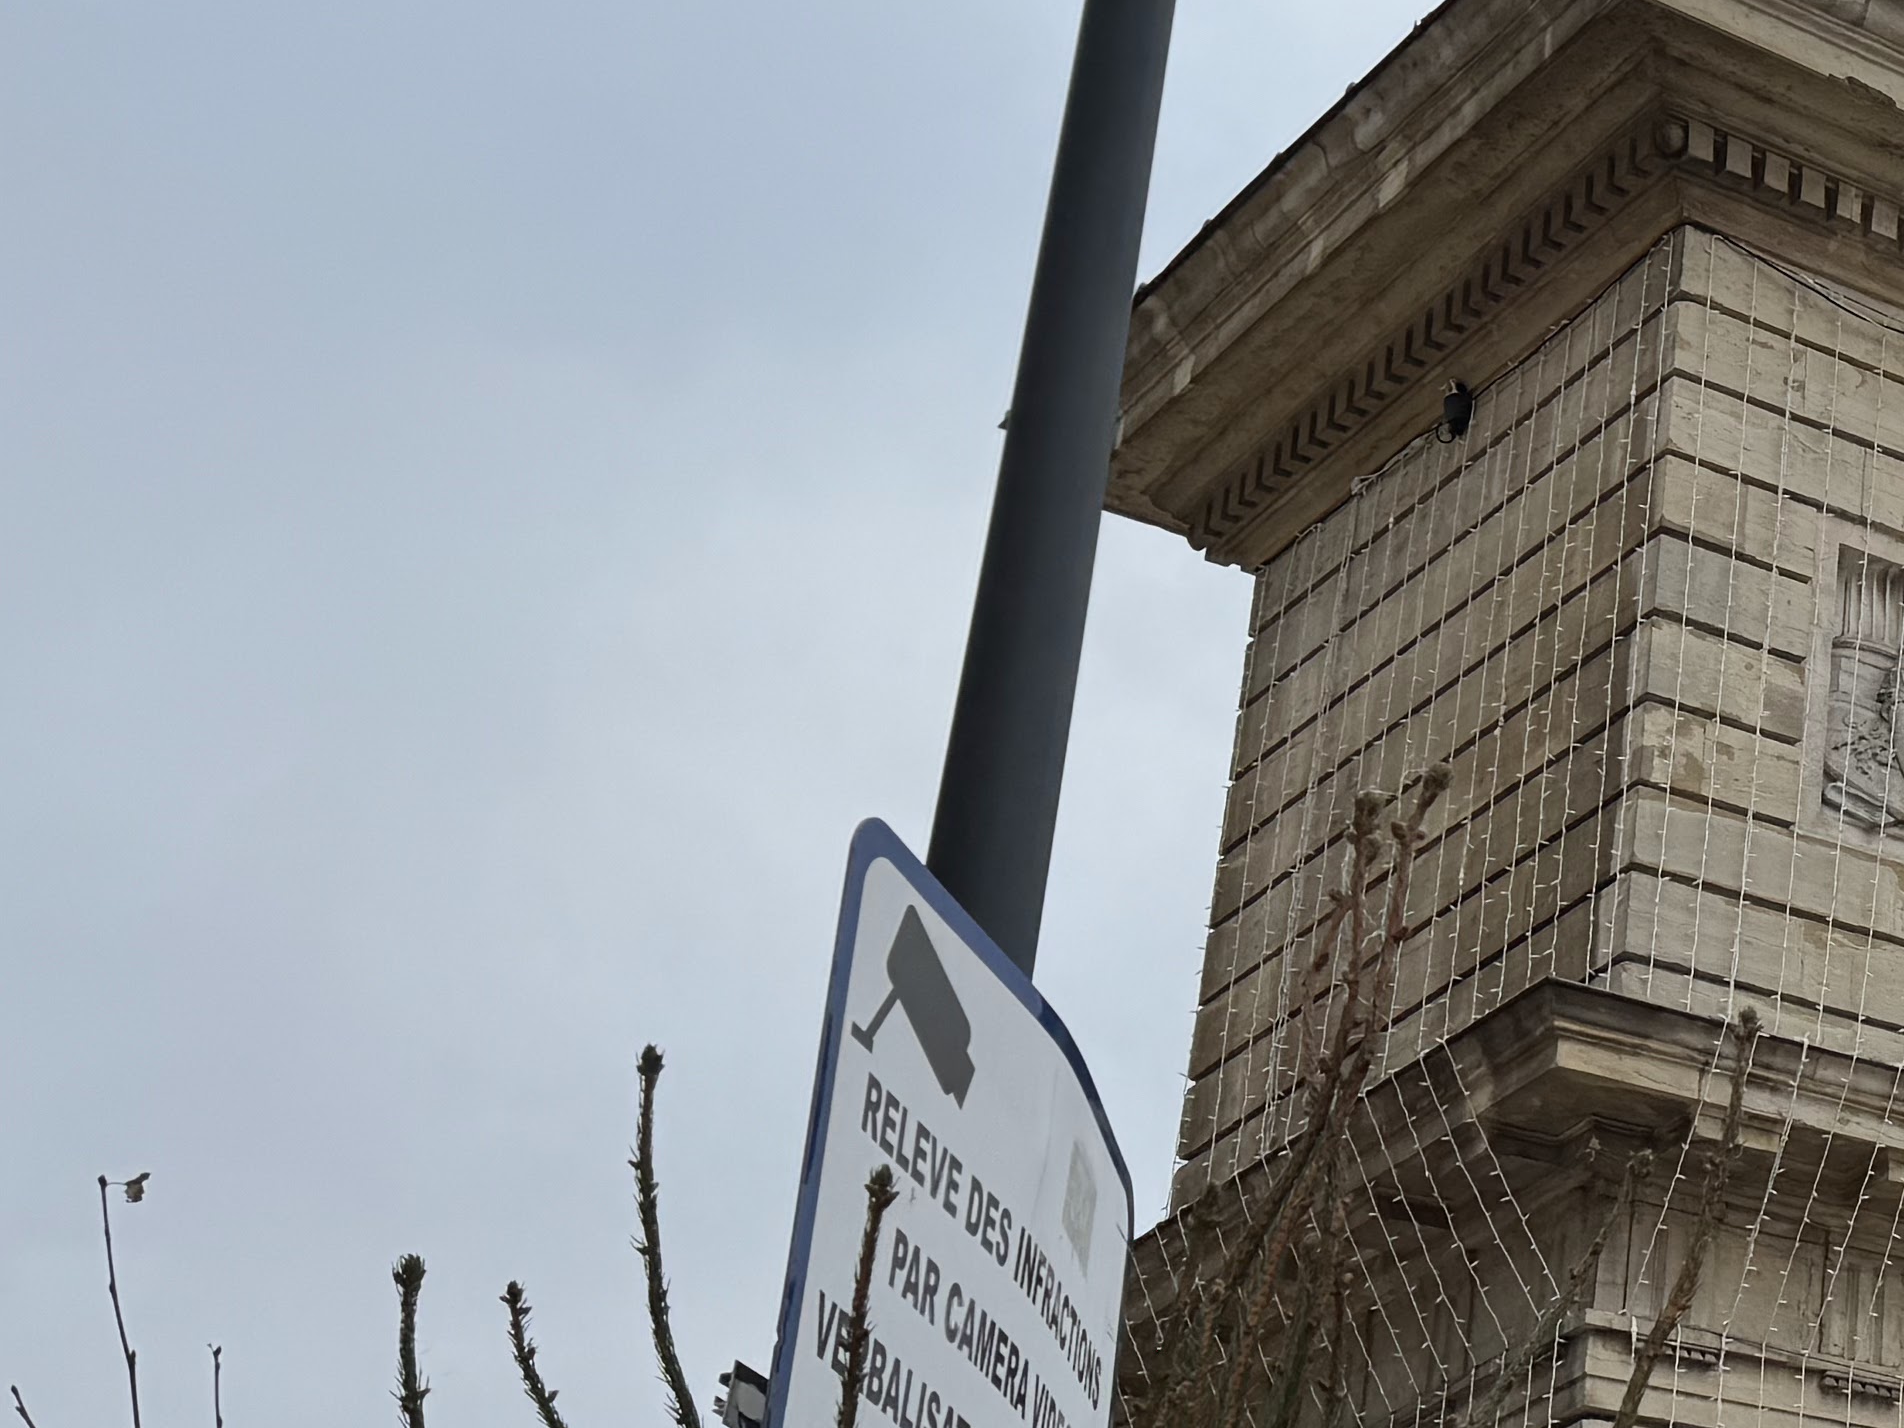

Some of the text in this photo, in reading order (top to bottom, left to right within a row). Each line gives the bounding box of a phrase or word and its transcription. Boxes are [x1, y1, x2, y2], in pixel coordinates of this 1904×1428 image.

[861, 1072, 1102, 1411] RELEVE DES INFRACTIONS
[888, 1227, 940, 1326] PAR
[944, 1282, 1029, 1420] CAMERA
